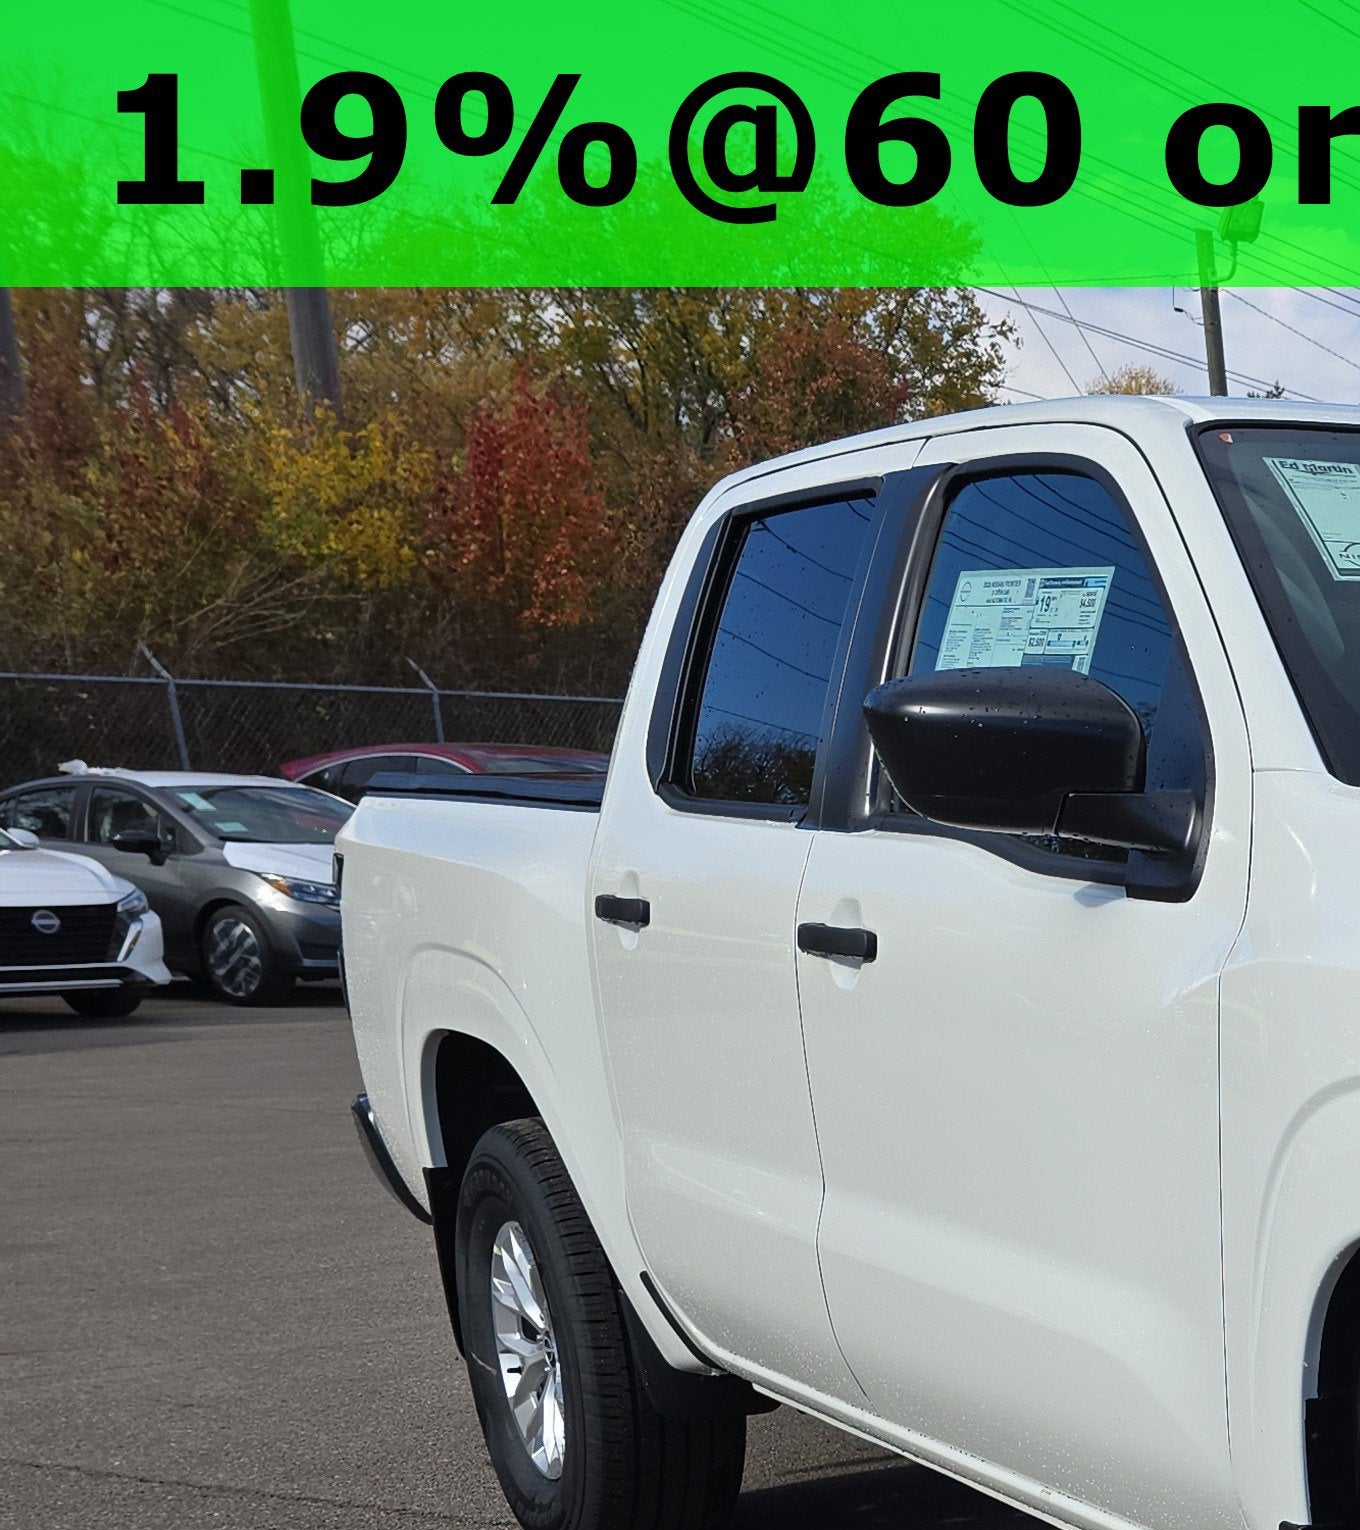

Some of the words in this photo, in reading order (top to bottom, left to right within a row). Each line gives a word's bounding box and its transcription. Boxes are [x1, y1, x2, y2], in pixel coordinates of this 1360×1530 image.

[1278, 460, 1299, 470] Ed
[1301, 463, 1354, 475] Martin
[1039, 595, 1052, 613] 19
